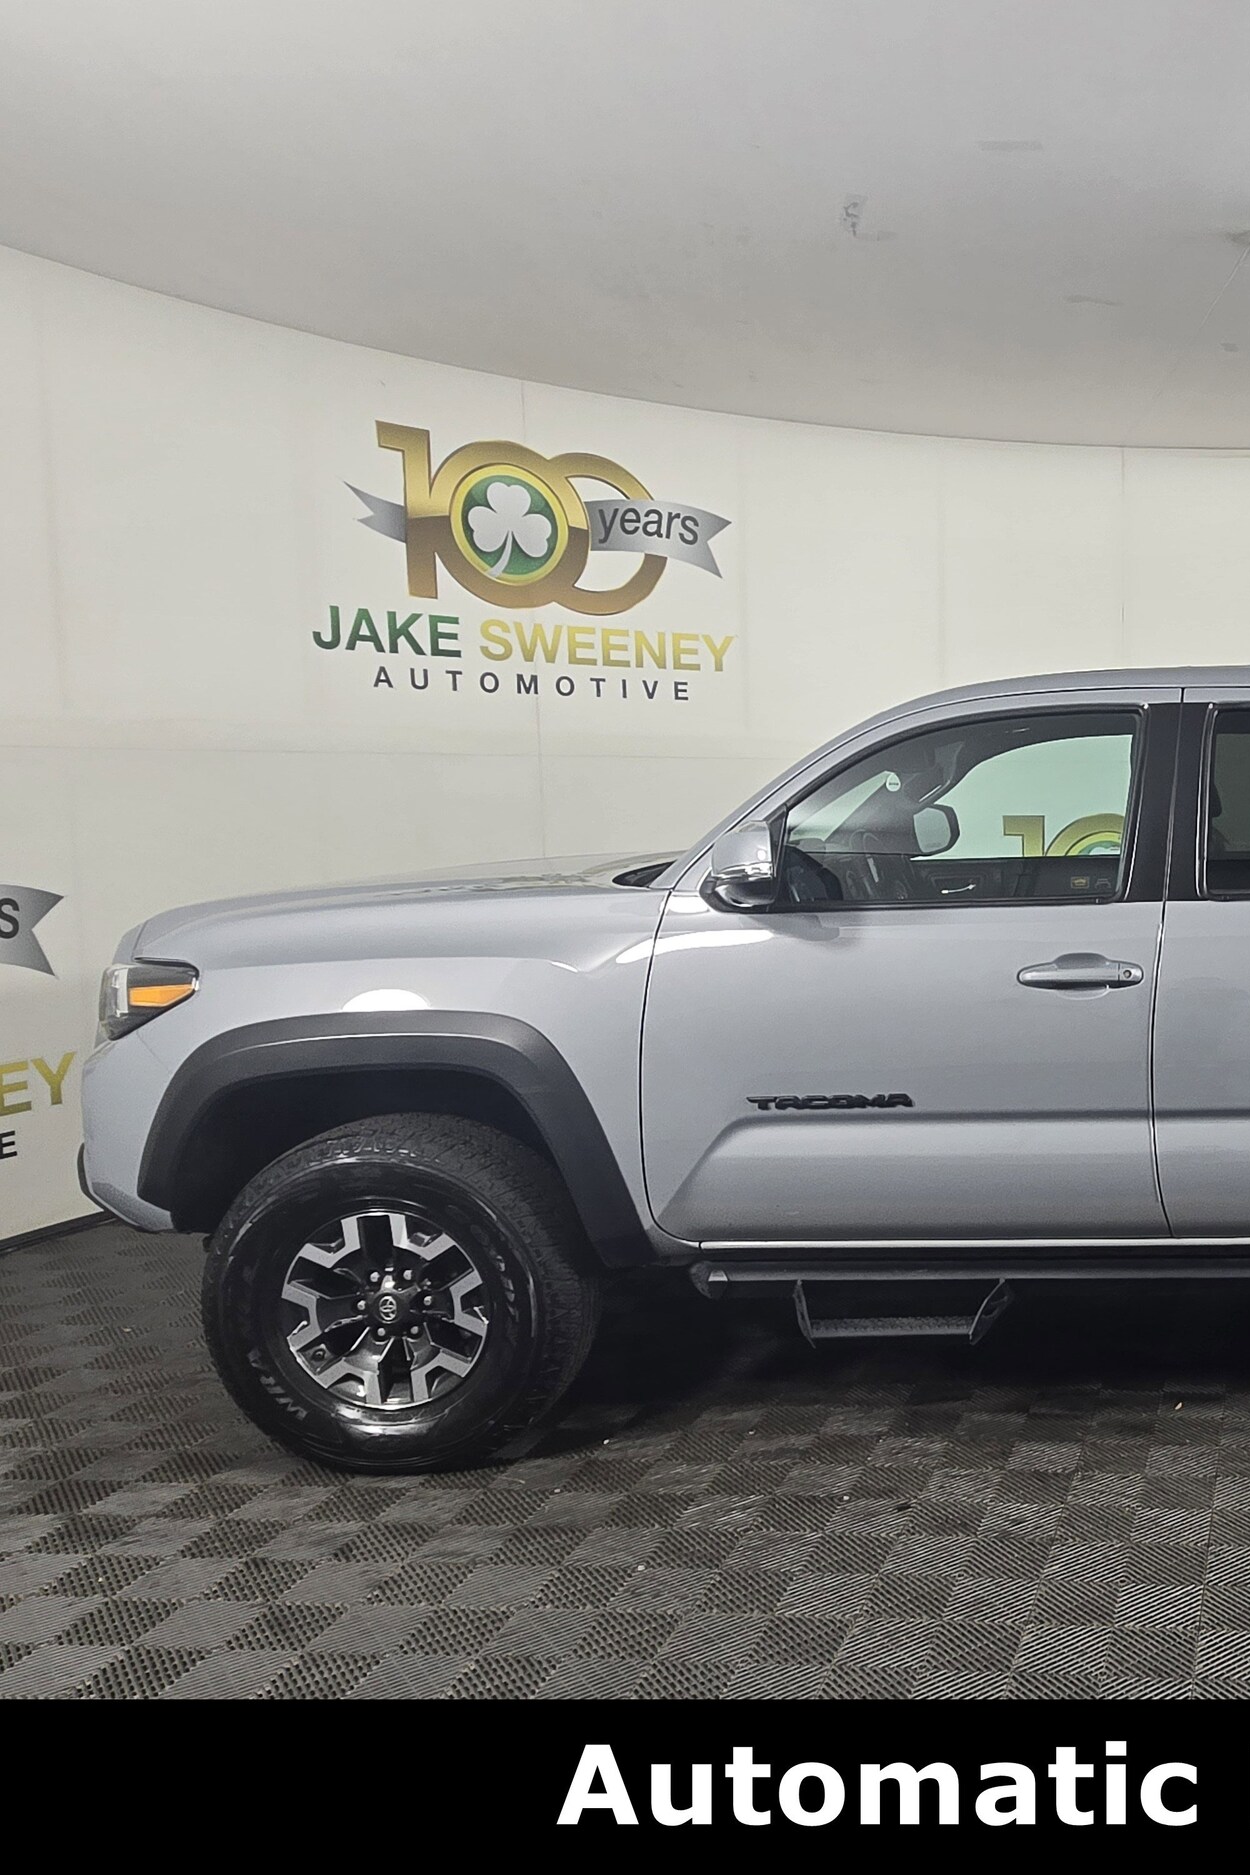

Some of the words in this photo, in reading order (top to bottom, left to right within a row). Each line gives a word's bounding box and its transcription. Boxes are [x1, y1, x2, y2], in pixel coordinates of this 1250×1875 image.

[375, 419, 668, 617] 100
[597, 506, 700, 546] years
[312, 604, 463, 658] JAKE
[479, 618, 736, 672] SWEENEY
[373, 665, 690, 702] AUTOMOTIVE
[746, 1093, 915, 1111] TACOMA
